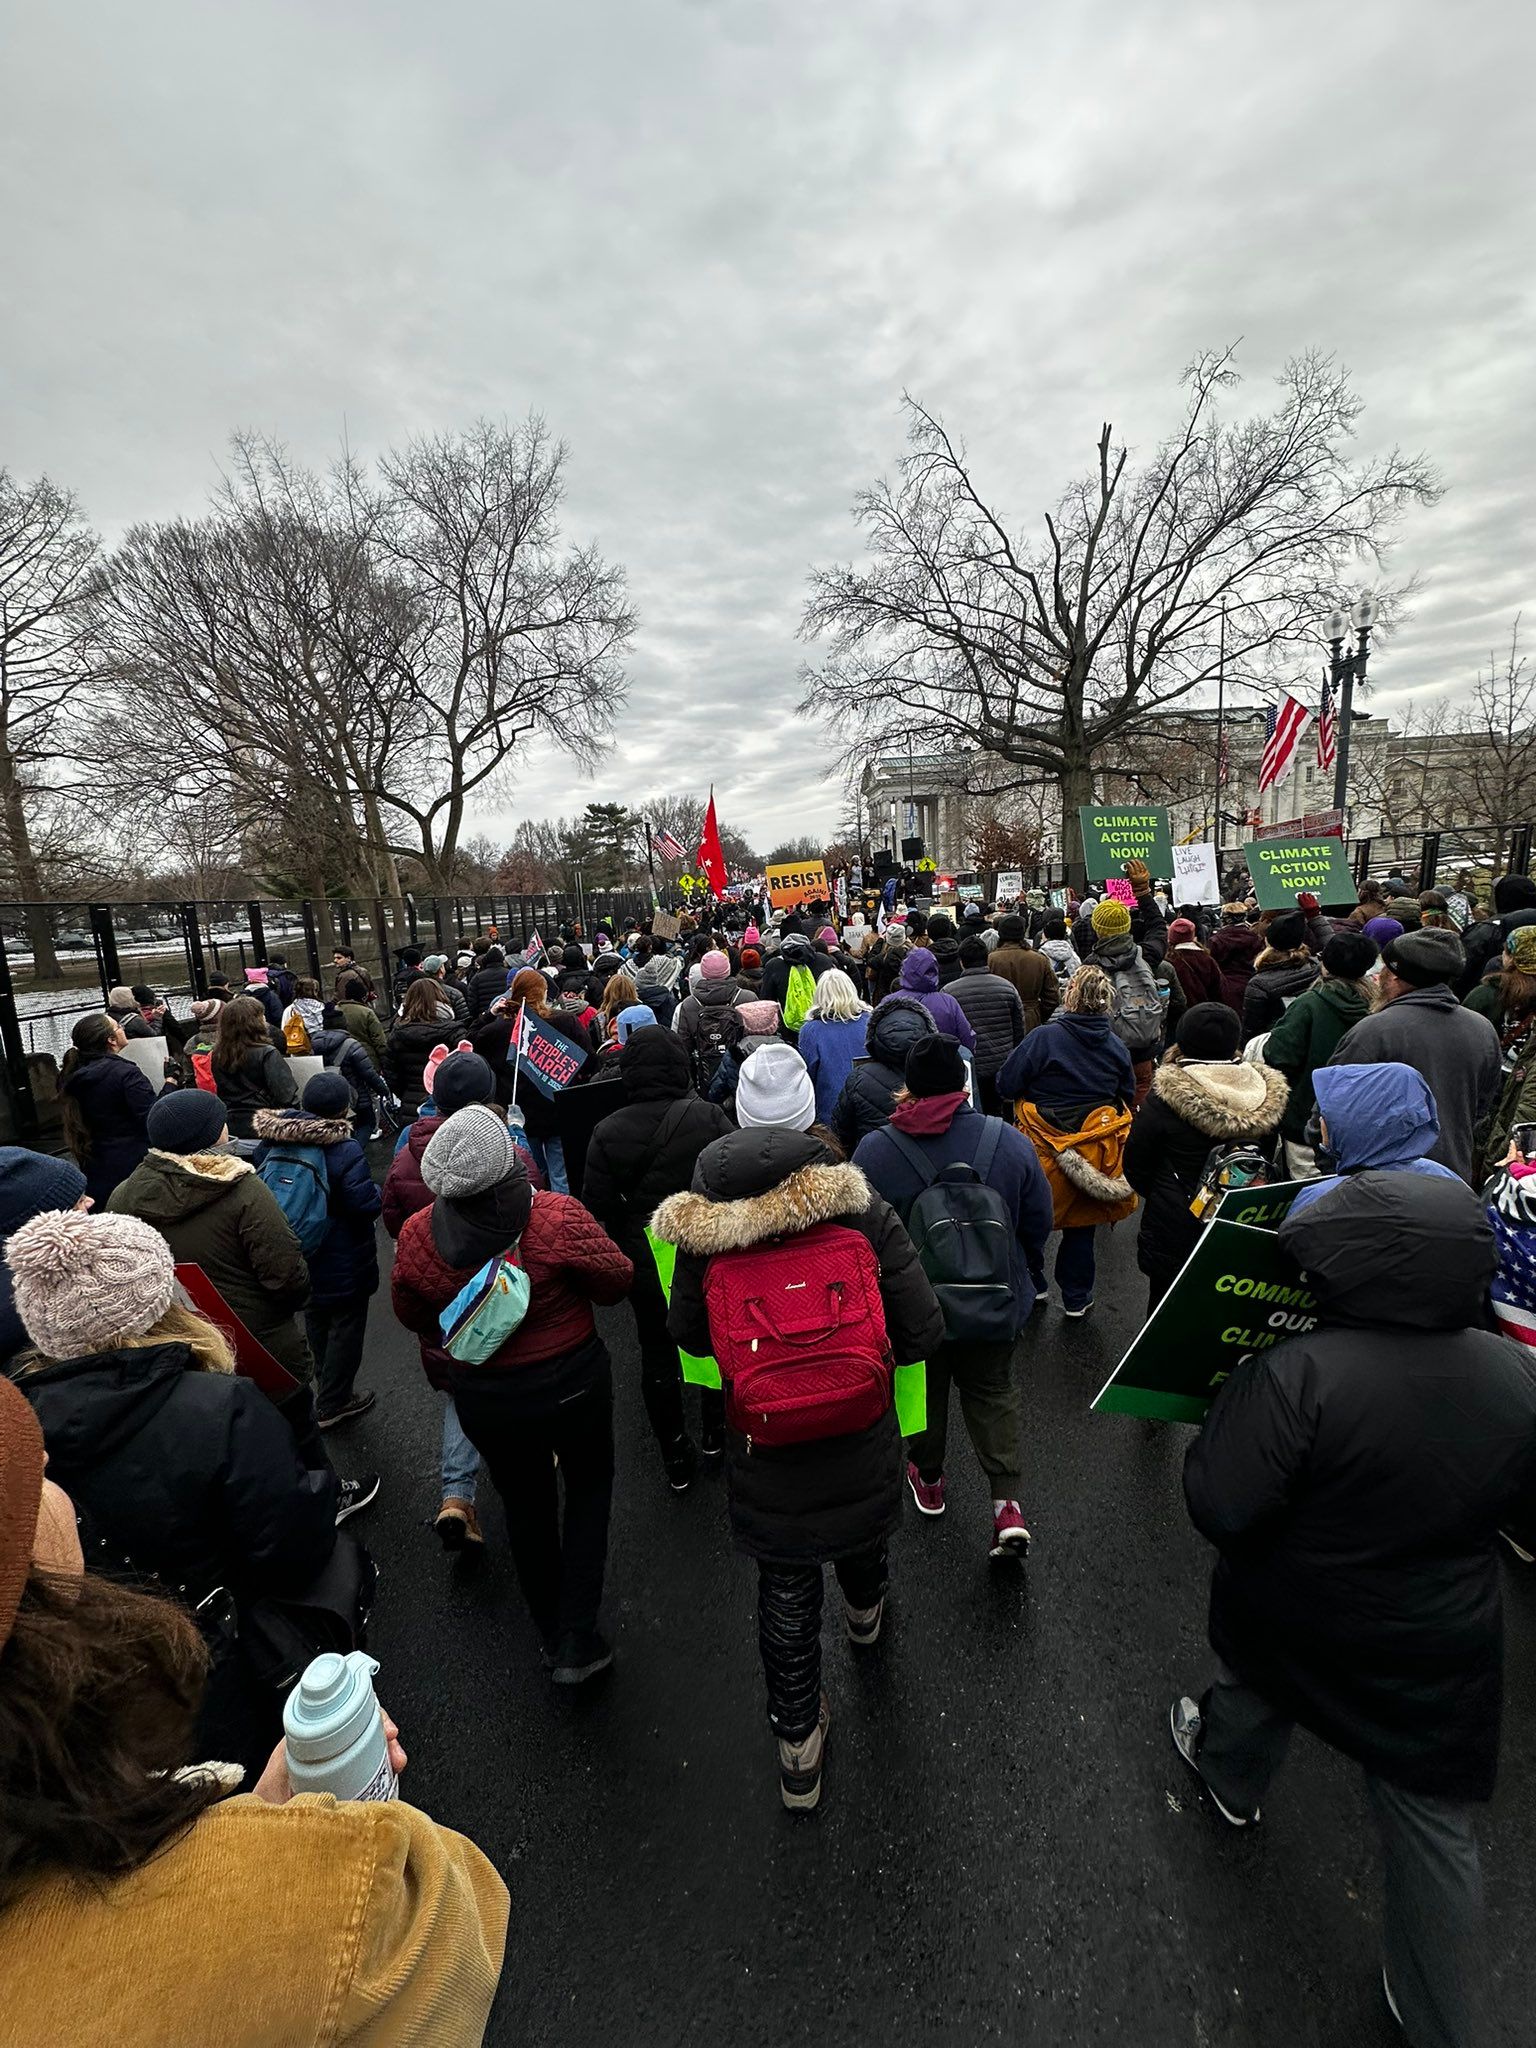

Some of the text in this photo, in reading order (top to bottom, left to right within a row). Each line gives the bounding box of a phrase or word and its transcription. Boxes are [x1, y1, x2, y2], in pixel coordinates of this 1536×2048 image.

[1093, 816, 1158, 827] CLIMATE
[1100, 832, 1155, 843] ACTION
[1109, 847, 1150, 858] NOW!
[1174, 846, 1193, 856] LIVE
[1259, 846, 1332, 861] CLIMATE
[1176, 854, 1201, 865] LAUGH
[1269, 860, 1331, 875] ACTION
[770, 872, 822, 890] RESIST
[1281, 875, 1327, 888] NOW!
[553, 1038, 569, 1052] THE
[532, 1035, 579, 1073] PEOPLE'S
[528, 1045, 572, 1084] MARCH
[1215, 1274, 1317, 1309] COMMU
